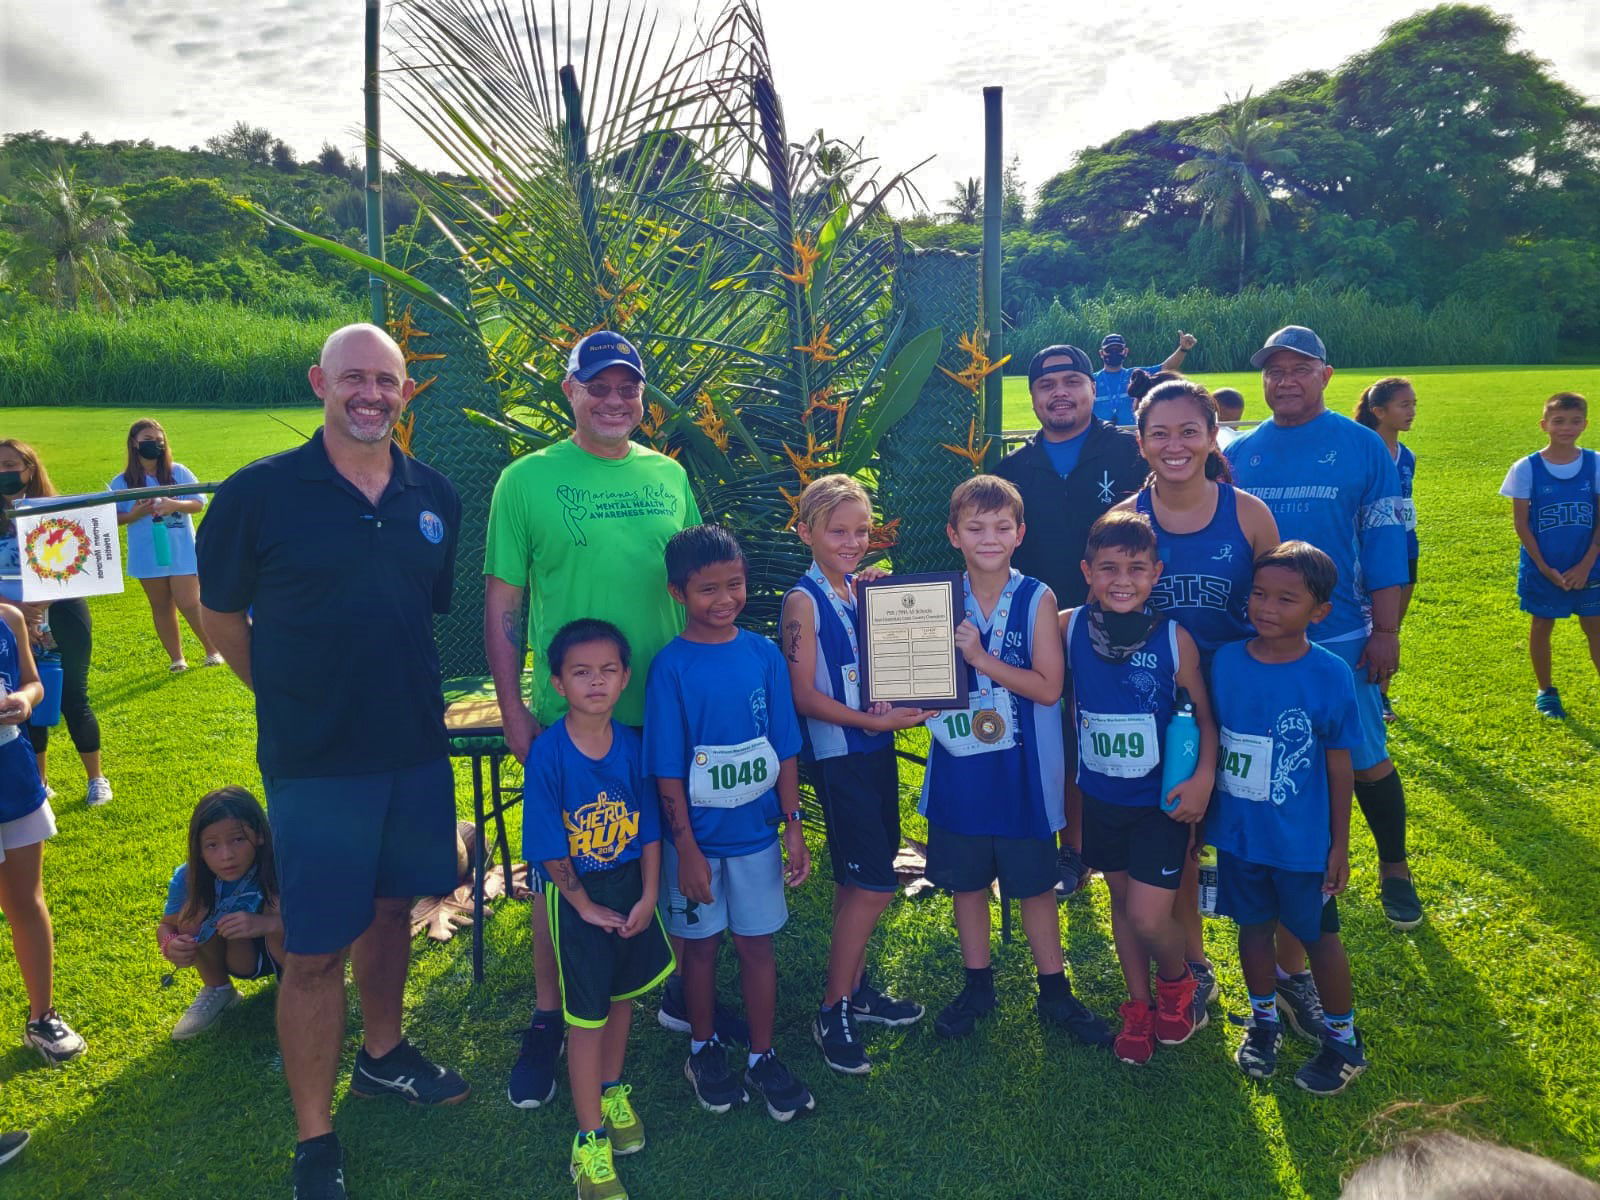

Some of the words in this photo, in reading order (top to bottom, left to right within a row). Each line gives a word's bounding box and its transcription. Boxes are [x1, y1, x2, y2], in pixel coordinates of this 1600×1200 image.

[589, 344, 615, 352] Rotary
[567, 487, 639, 503] Marianas
[642, 483, 678, 512] Relay
[595, 500, 632, 510] MENTAL
[633, 499, 665, 508] HEALTH
[1283, 485, 1339, 500] MARIANAS
[589, 509, 645, 520] AWARENESS
[647, 508, 675, 517] MONTH
[1538, 501, 1594, 533] SIS
[1147, 573, 1233, 612] SIS
[1129, 651, 1158, 669] SIS
[1280, 716, 1305, 734] SIS
[1090, 731, 1145, 758] 1049
[707, 756, 768, 791] 1048
[580, 804, 626, 832] HERO
[569, 811, 640, 857] RUN
